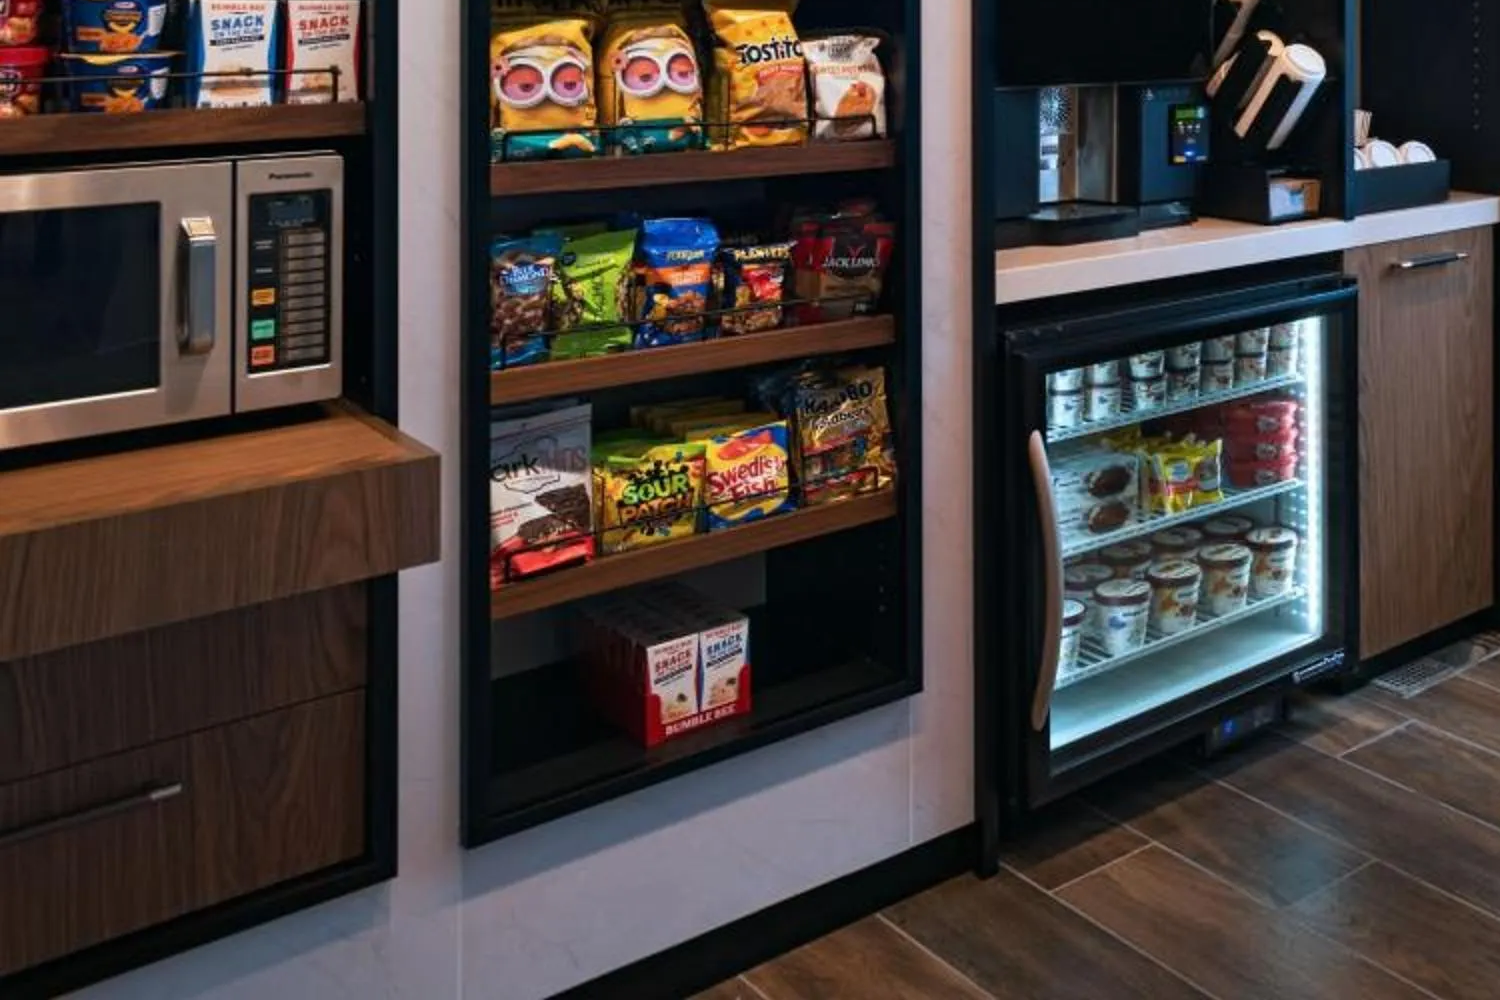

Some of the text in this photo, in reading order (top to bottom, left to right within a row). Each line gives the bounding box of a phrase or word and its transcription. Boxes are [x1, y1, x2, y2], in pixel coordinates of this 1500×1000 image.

[211, 15, 265, 31] SNACK
[298, 15, 350, 31] SNACK
[706, 454, 789, 495] Swedish
[622, 472, 690, 505] SOUR
